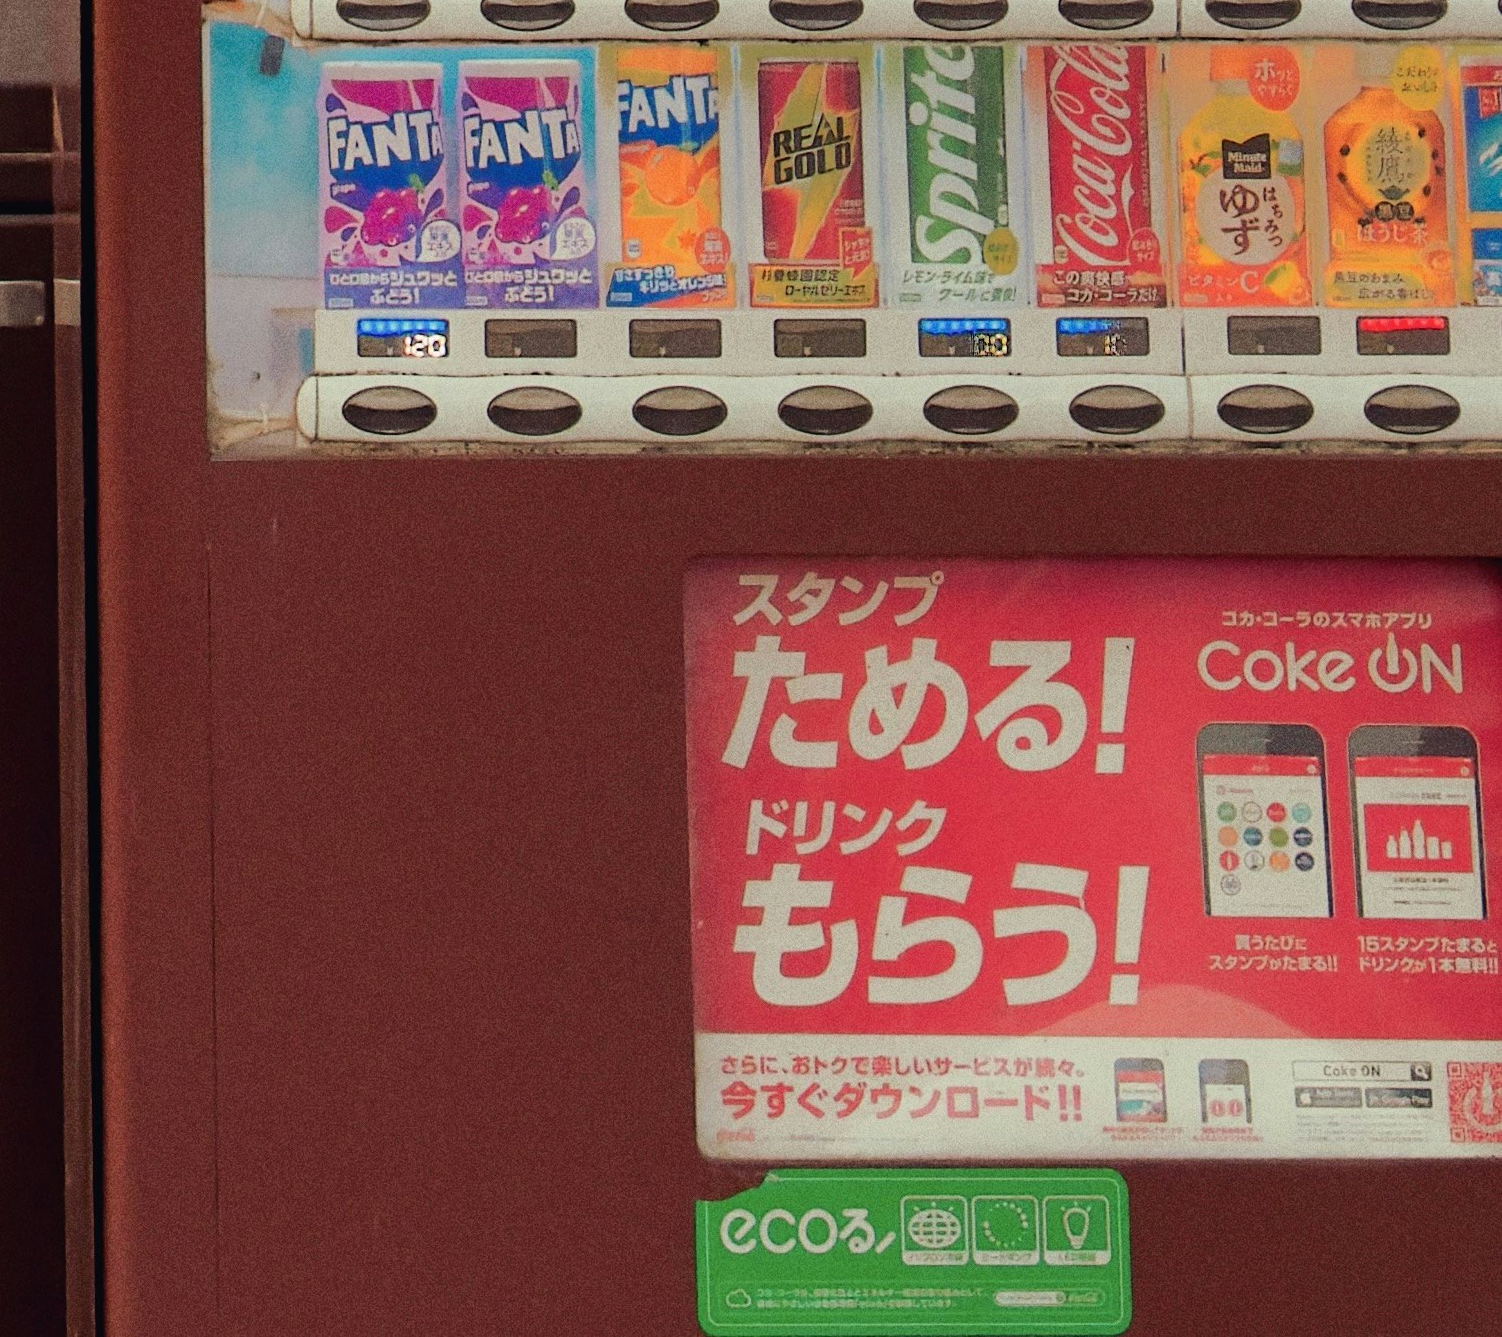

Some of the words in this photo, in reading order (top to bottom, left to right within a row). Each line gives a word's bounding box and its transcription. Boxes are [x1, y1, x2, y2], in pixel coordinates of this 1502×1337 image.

[327, 112, 444, 171] FANTA
[464, 110, 579, 169] FANTA
[773, 113, 850, 158] REAL
[1228, 152, 1267, 163] Minute
[773, 142, 851, 185] GOLD
[1219, 184, 1260, 255] ゆず
[1262, 186, 1283, 247] はちみつ
[1357, 223, 1429, 243] ほうじ茶
[405, 335, 447, 357] 120
[732, 571, 945, 626] スタンプ
[1222, 610, 1432, 630] コカ・コーラのスマホアプリ
[1198, 639, 1356, 692] Coke
[1368, 631, 1463, 694] ON
[721, 635, 1135, 774] ためる!
[745, 799, 947, 856] ドリンク
[733, 863, 1150, 1007] もらう!
[1235, 934, 1307, 951] 買うたびに
[1357, 936, 1497, 954] 15スタンプたまると
[721, 1055, 1085, 1078] さらに、おトクで楽しいサービスが続々。
[1322, 1065, 1356, 1078] Coke
[1361, 1065, 1381, 1078] ON
[721, 1081, 1083, 1121] 今すぐダウンロード!!
